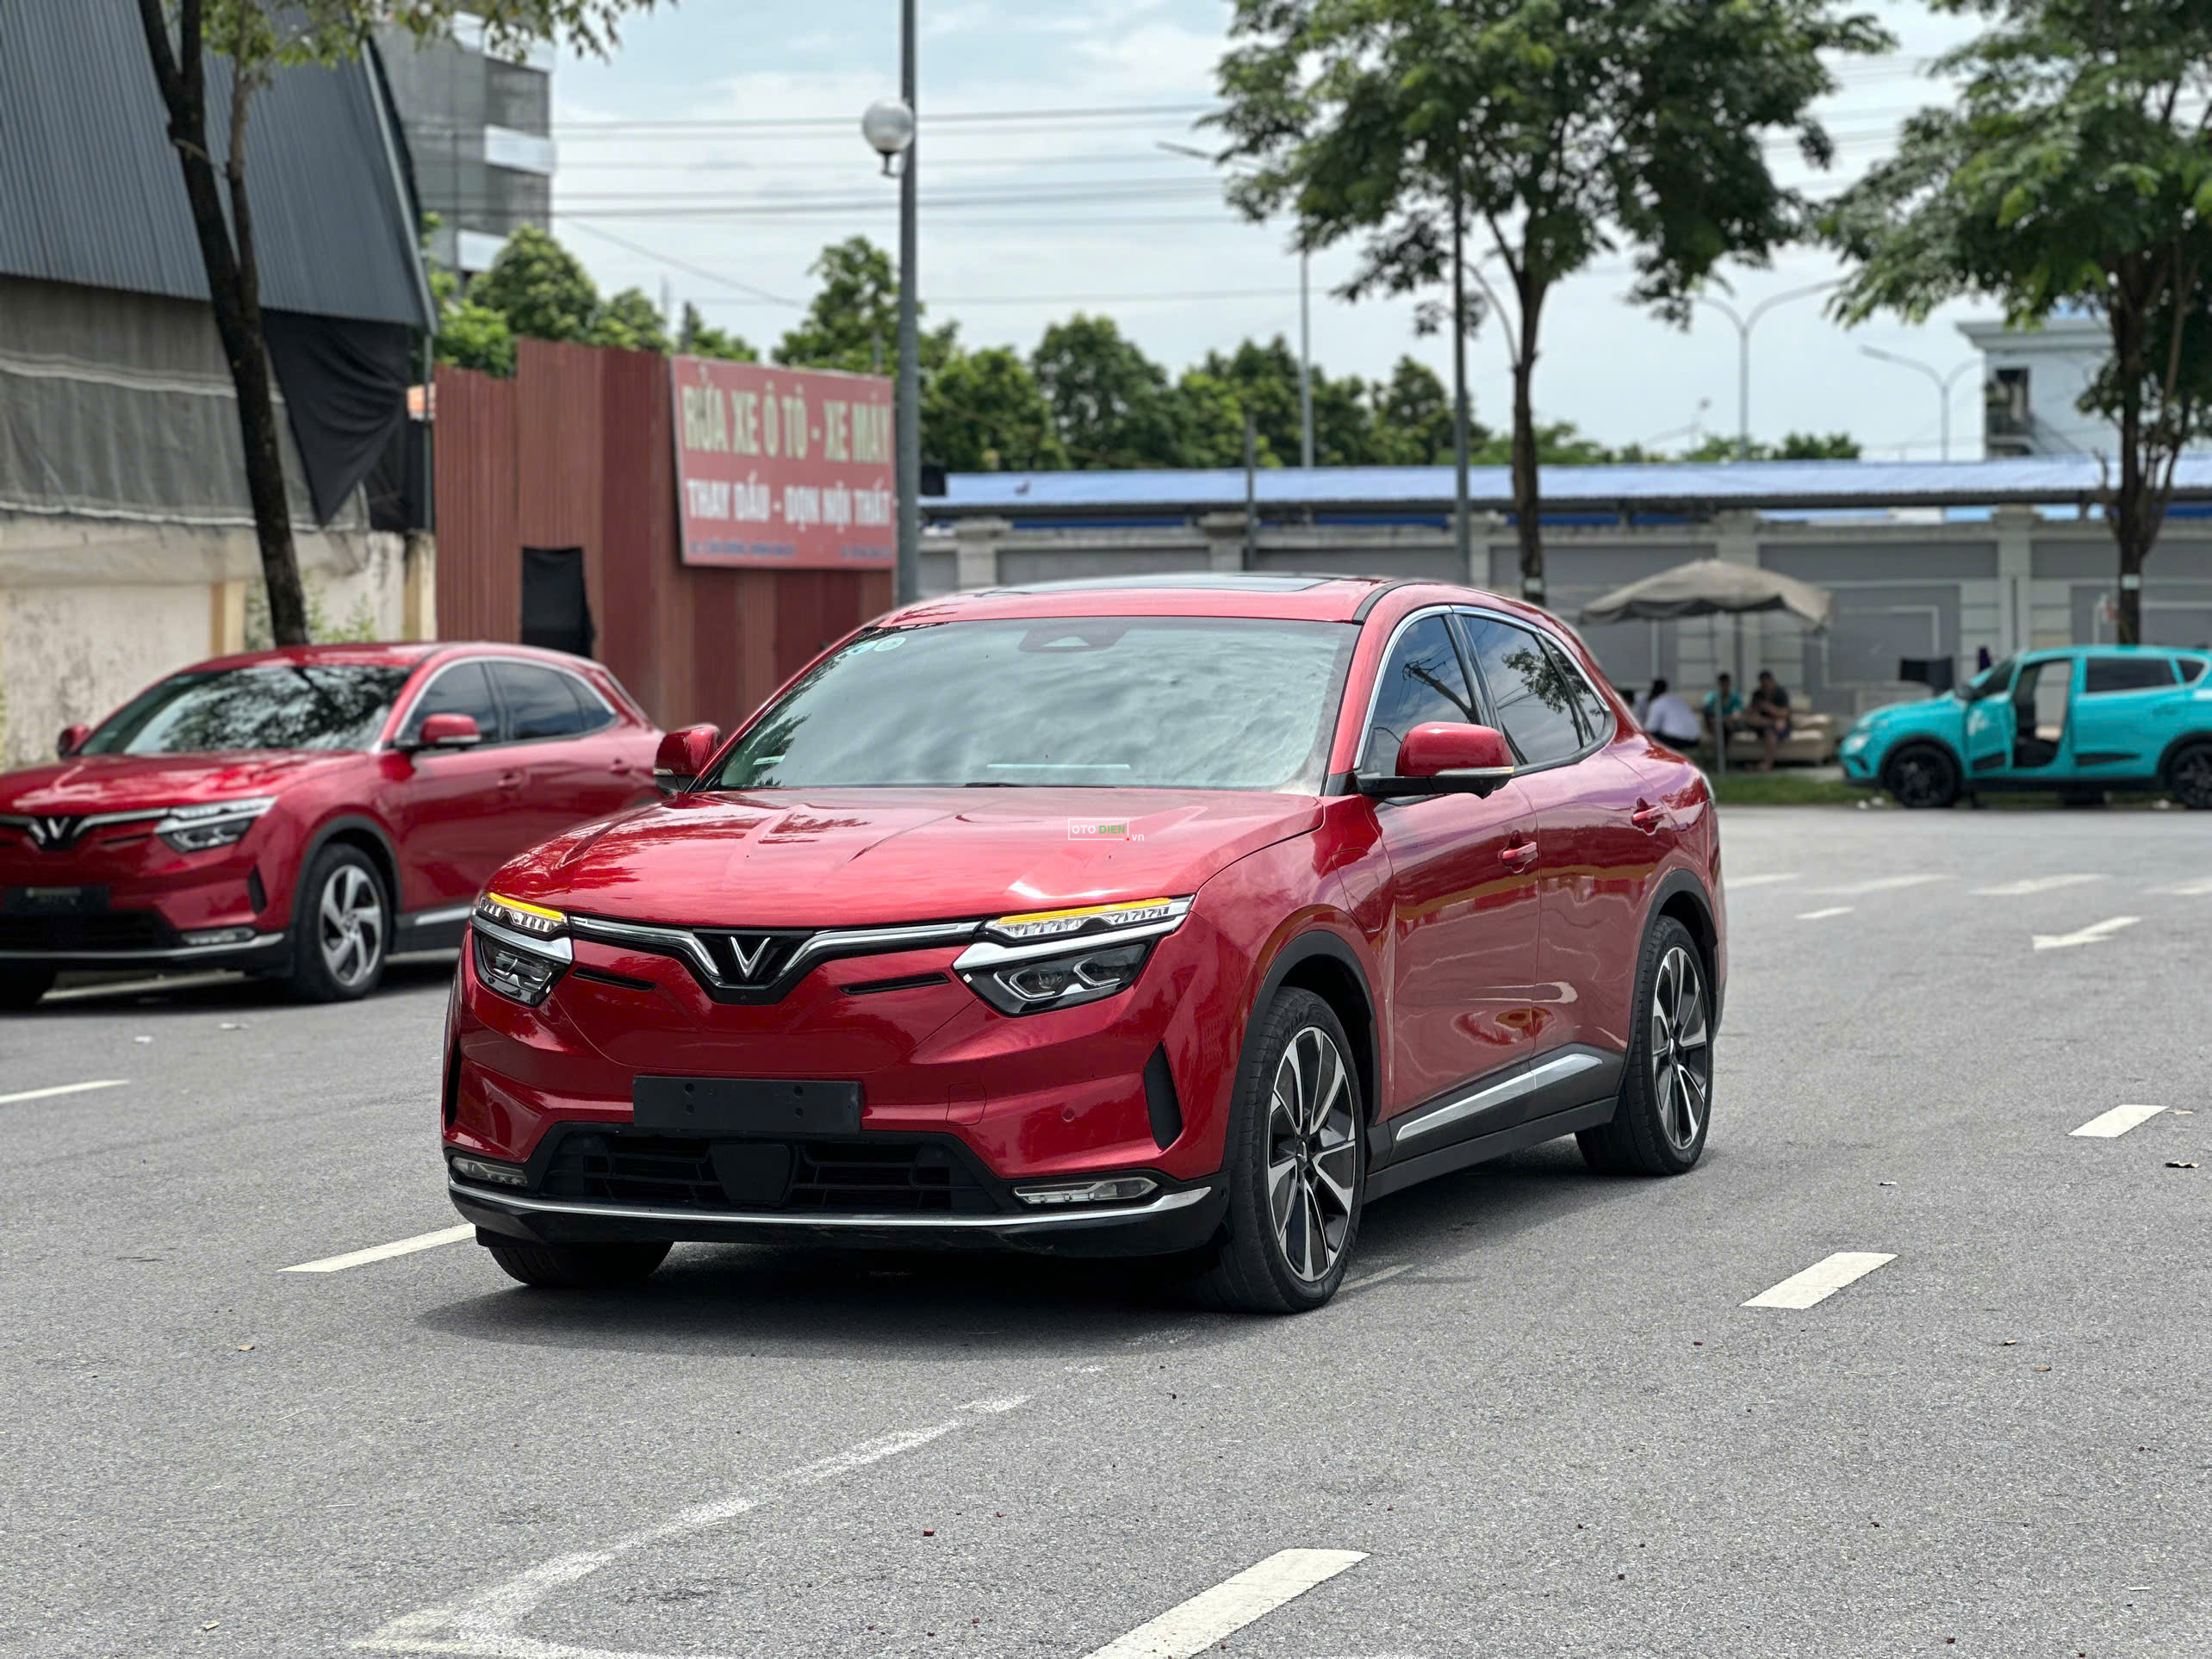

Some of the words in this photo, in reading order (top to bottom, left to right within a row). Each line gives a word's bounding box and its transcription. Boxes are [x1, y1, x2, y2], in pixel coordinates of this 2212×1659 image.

[731, 390, 760, 456] XE
[763, 380, 779, 458] Ô
[780, 384, 808, 460] TÔ
[823, 399, 848, 463] XE
[687, 477, 730, 520] THAY
